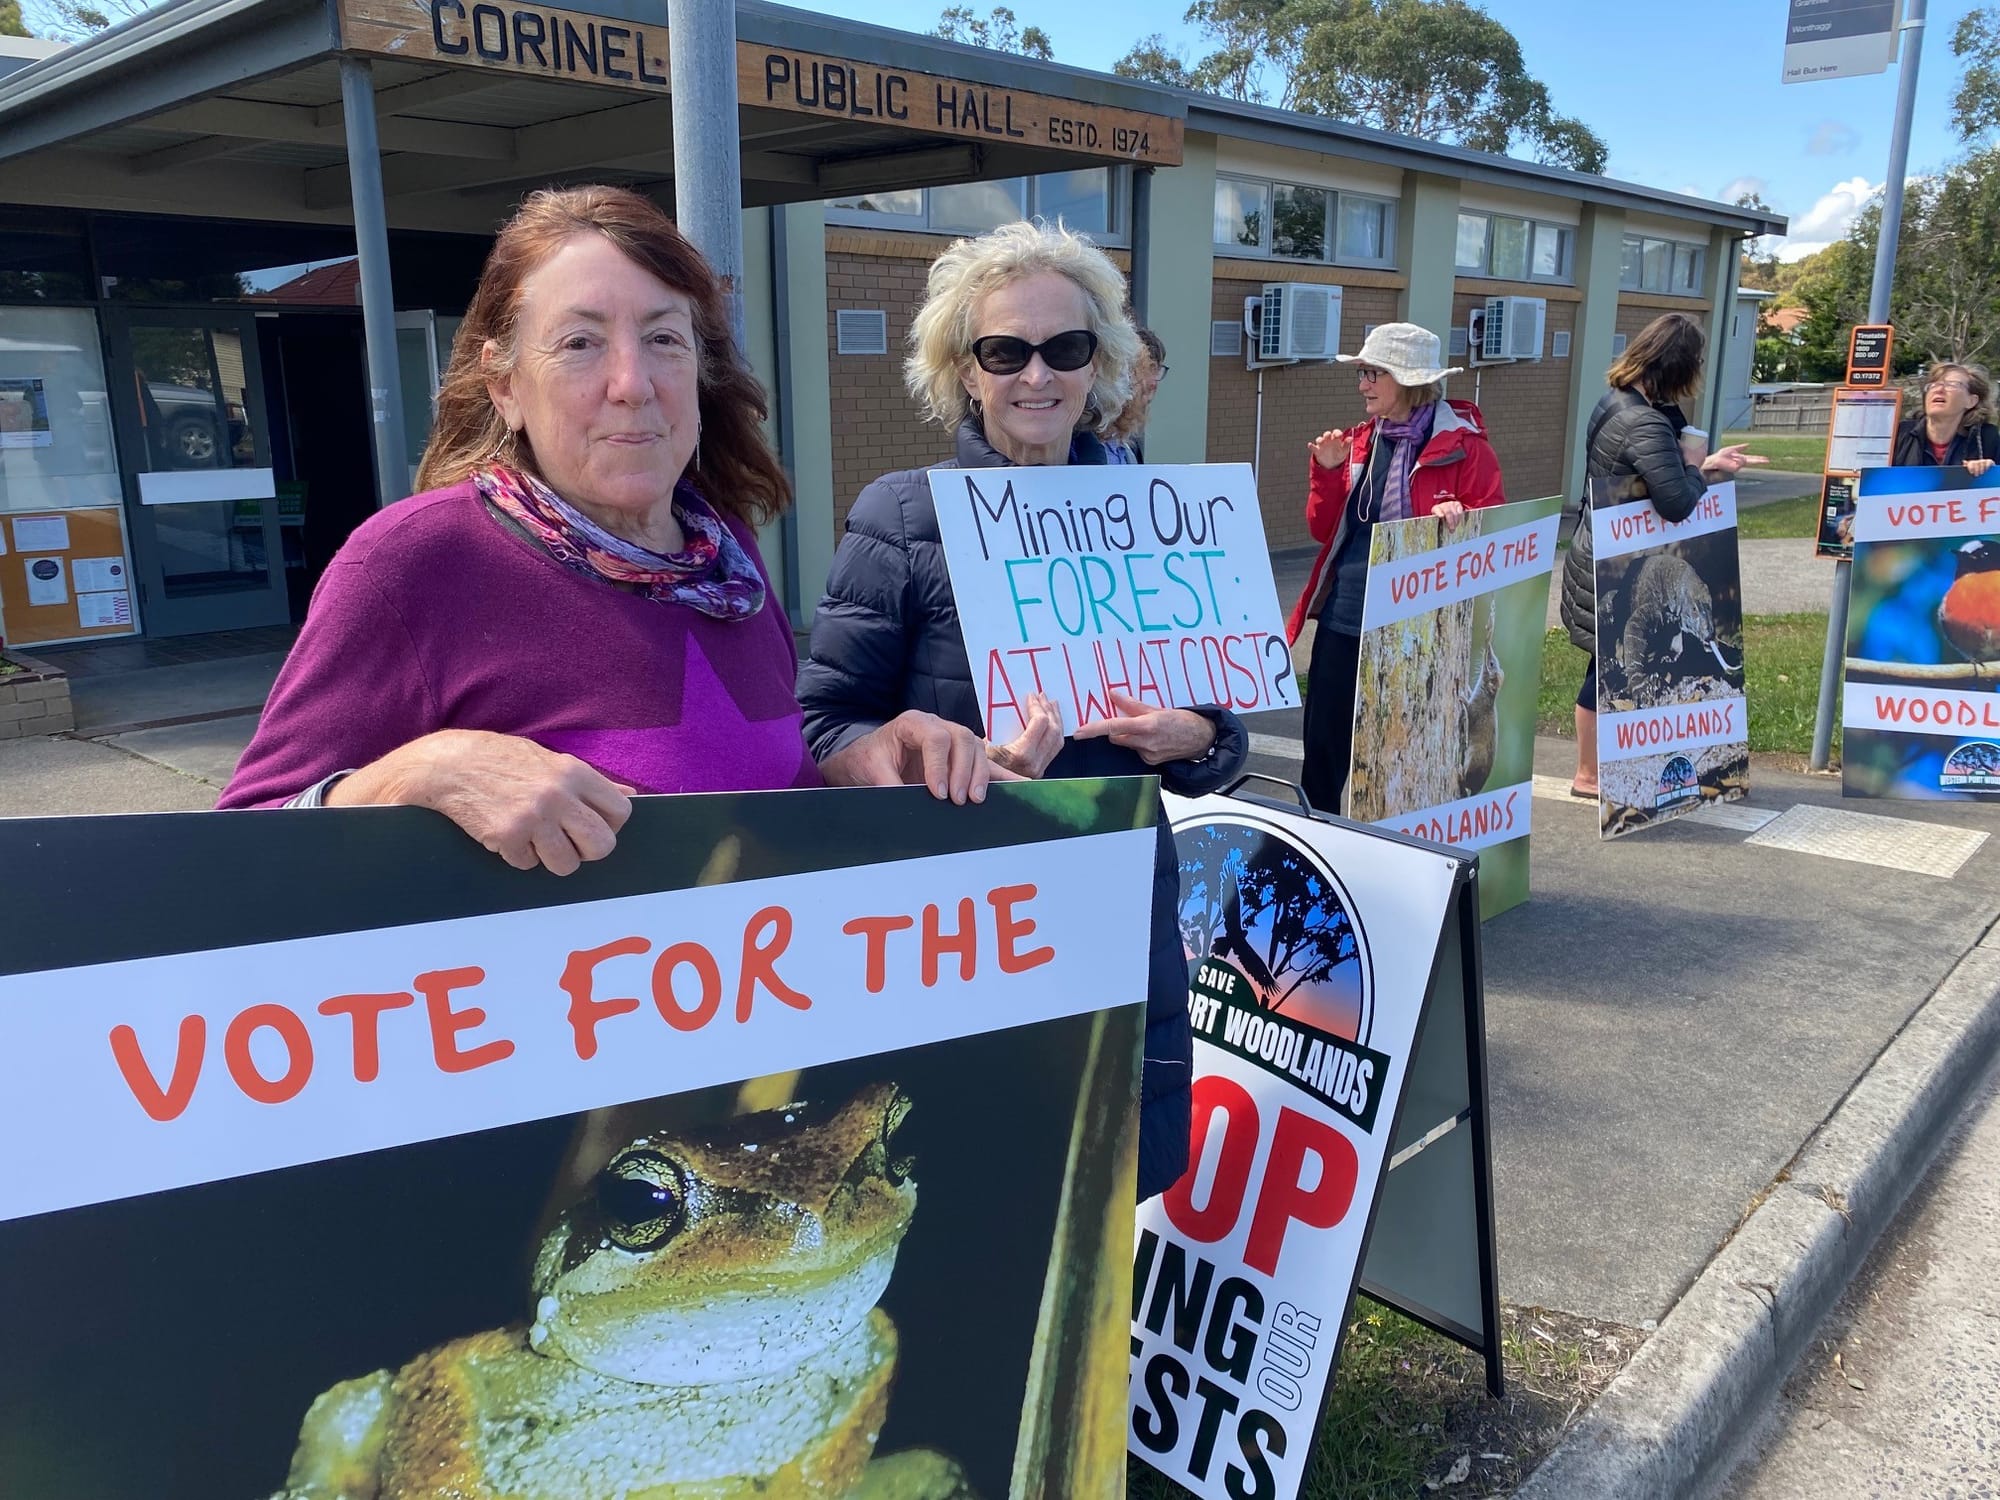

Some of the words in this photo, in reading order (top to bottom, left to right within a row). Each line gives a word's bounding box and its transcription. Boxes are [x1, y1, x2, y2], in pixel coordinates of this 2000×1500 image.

[431, 0, 668, 86] CORINEL
[765, 54, 909, 121] PUBLIC
[936, 83, 1025, 139] HALL
[1049, 117, 1102, 149] ESTD.
[1112, 128, 1150, 156] 1974
[965, 475, 1136, 561] Mining
[1149, 478, 1234, 546] Our
[1610, 510, 1656, 541] VOTE
[1696, 494, 1733, 520] THE
[1887, 500, 1967, 527] VOTE
[1005, 550, 1249, 643] FOREST:
[1391, 560, 1448, 606] VOTE
[1455, 541, 1496, 588] FOR
[1502, 531, 1539, 570] THE
[986, 646, 1052, 743] AT
[1062, 637, 1176, 728] WHAT
[1180, 631, 1291, 711] COST?
[1616, 703, 1734, 750] WOODLANDS
[1400, 791, 1518, 844] ODLANDS
[109, 966, 516, 1122] VOTE
[559, 905, 813, 1061] FOR
[842, 883, 1056, 993] THE
[1198, 964, 1236, 995] SAVE
[1187, 989, 1223, 1035] RT
[1223, 1005, 1375, 1117] WOODLANDS
[1162, 1074, 1359, 1279] OP
[1131, 1228, 1266, 1385] ING
[1257, 1301, 1322, 1412] OUR
